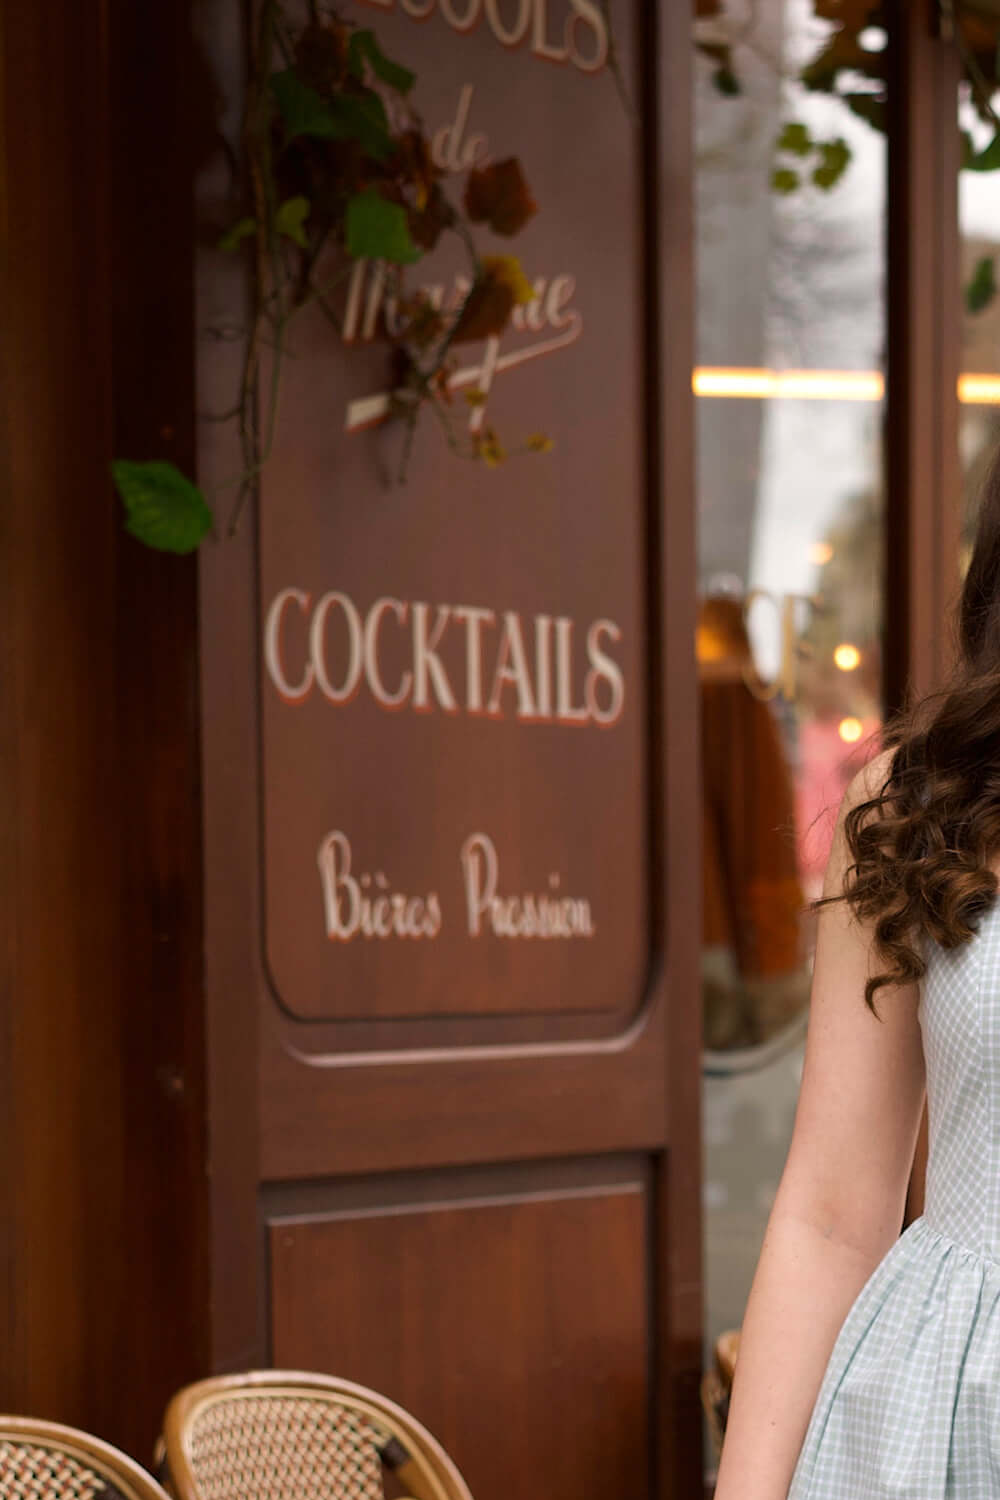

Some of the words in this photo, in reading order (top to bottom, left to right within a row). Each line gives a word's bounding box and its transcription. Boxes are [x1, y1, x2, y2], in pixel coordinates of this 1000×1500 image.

[430, 84, 491, 171] de
[265, 587, 625, 726] COCKTAILS
[318, 830, 441, 940] Bières
[461, 832, 594, 938] Pression
